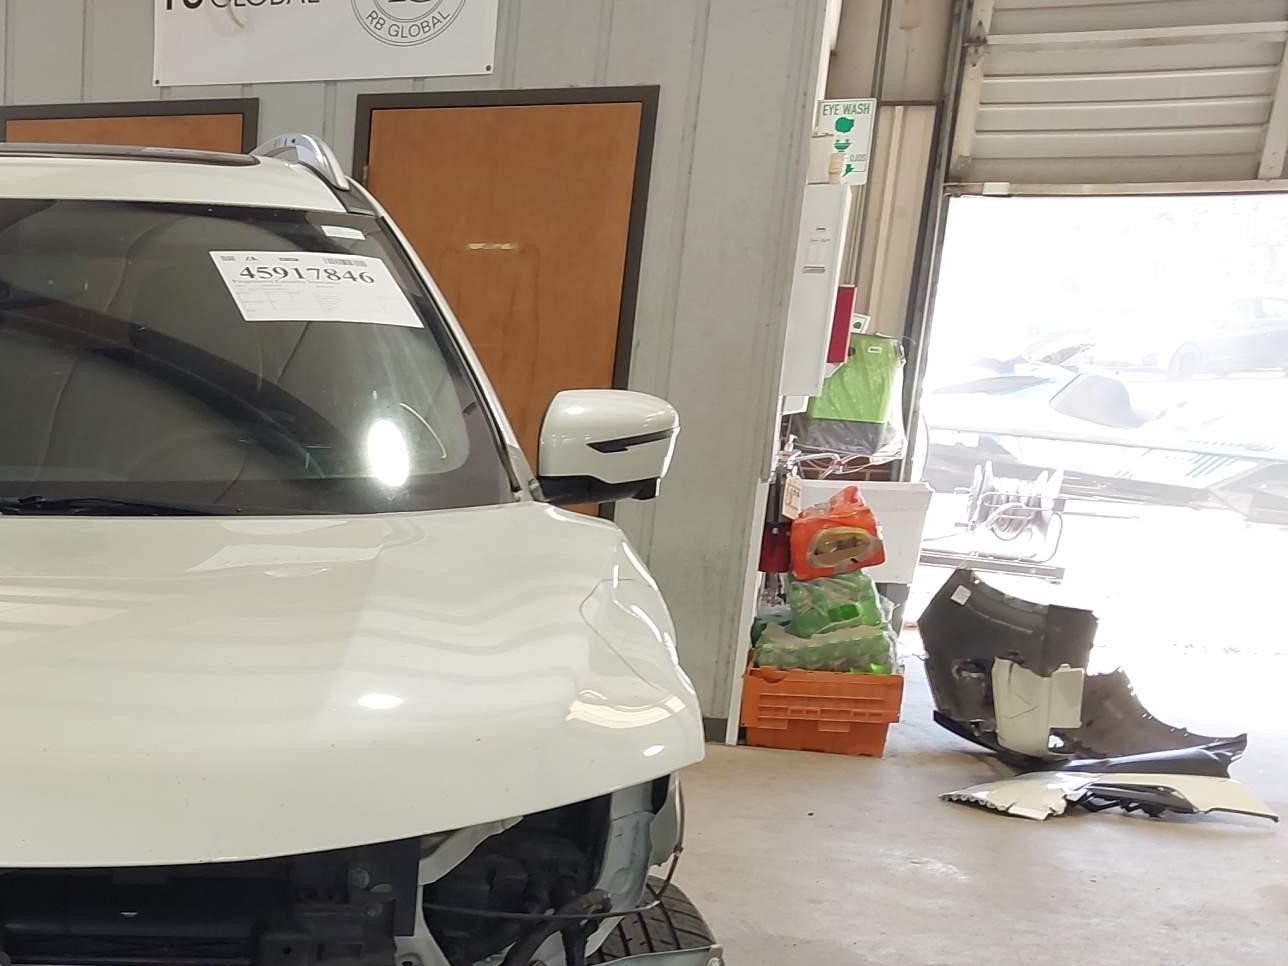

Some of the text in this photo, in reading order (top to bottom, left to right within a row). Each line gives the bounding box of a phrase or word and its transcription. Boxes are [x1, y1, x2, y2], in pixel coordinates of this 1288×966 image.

[365, 9, 450, 38] RB GLOBAL
[823, 103, 871, 116] EYE WASH
[240, 265, 375, 284] 45917846
